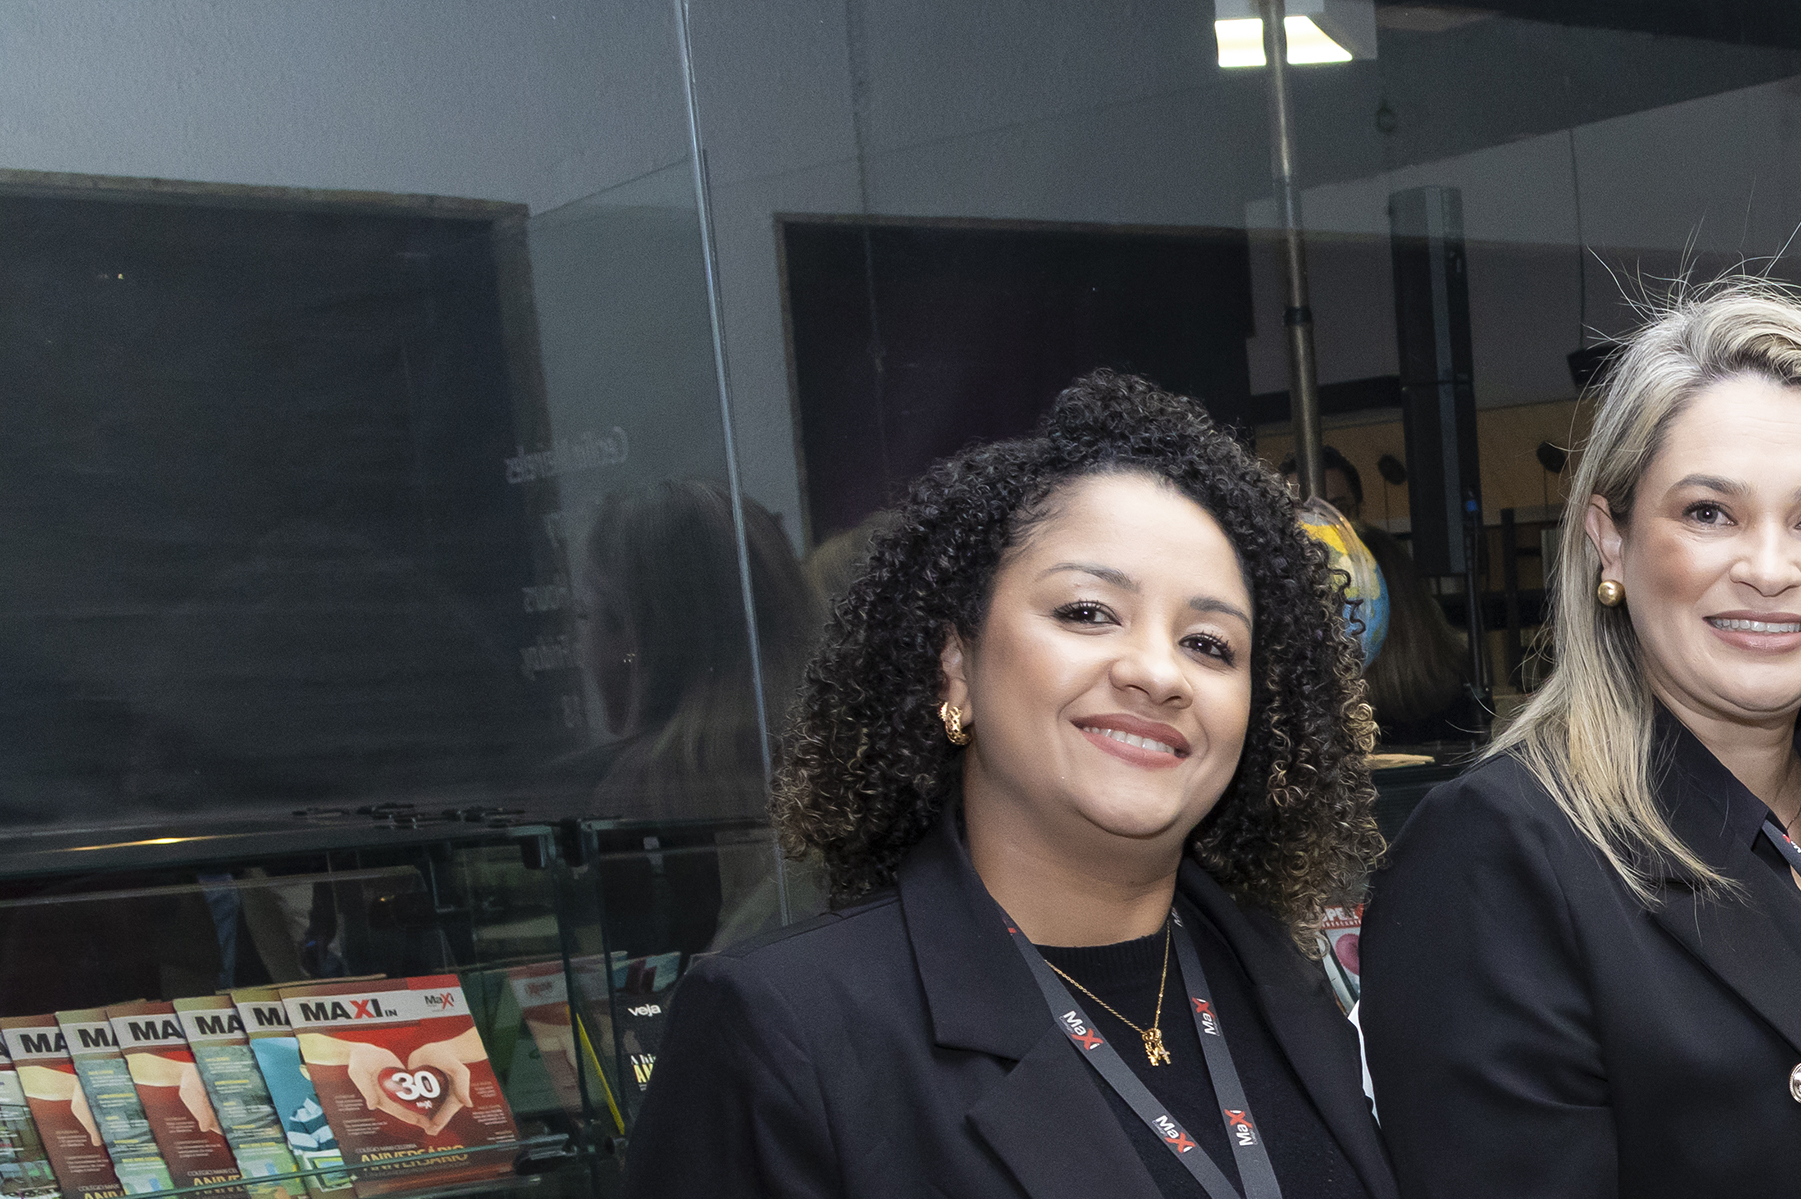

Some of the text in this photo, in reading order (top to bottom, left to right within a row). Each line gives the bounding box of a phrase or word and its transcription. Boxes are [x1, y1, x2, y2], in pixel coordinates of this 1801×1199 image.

[299, 998, 398, 1022] MAXI IN
[628, 1004, 661, 1017] veja
[1192, 997, 1217, 1037] MaXi
[128, 1019, 184, 1041] MA
[1063, 1010, 1104, 1051] MaXi
[391, 1070, 441, 1101] 30
[1155, 1114, 1196, 1154] MaXi
[1224, 1108, 1254, 1147] MaXi
